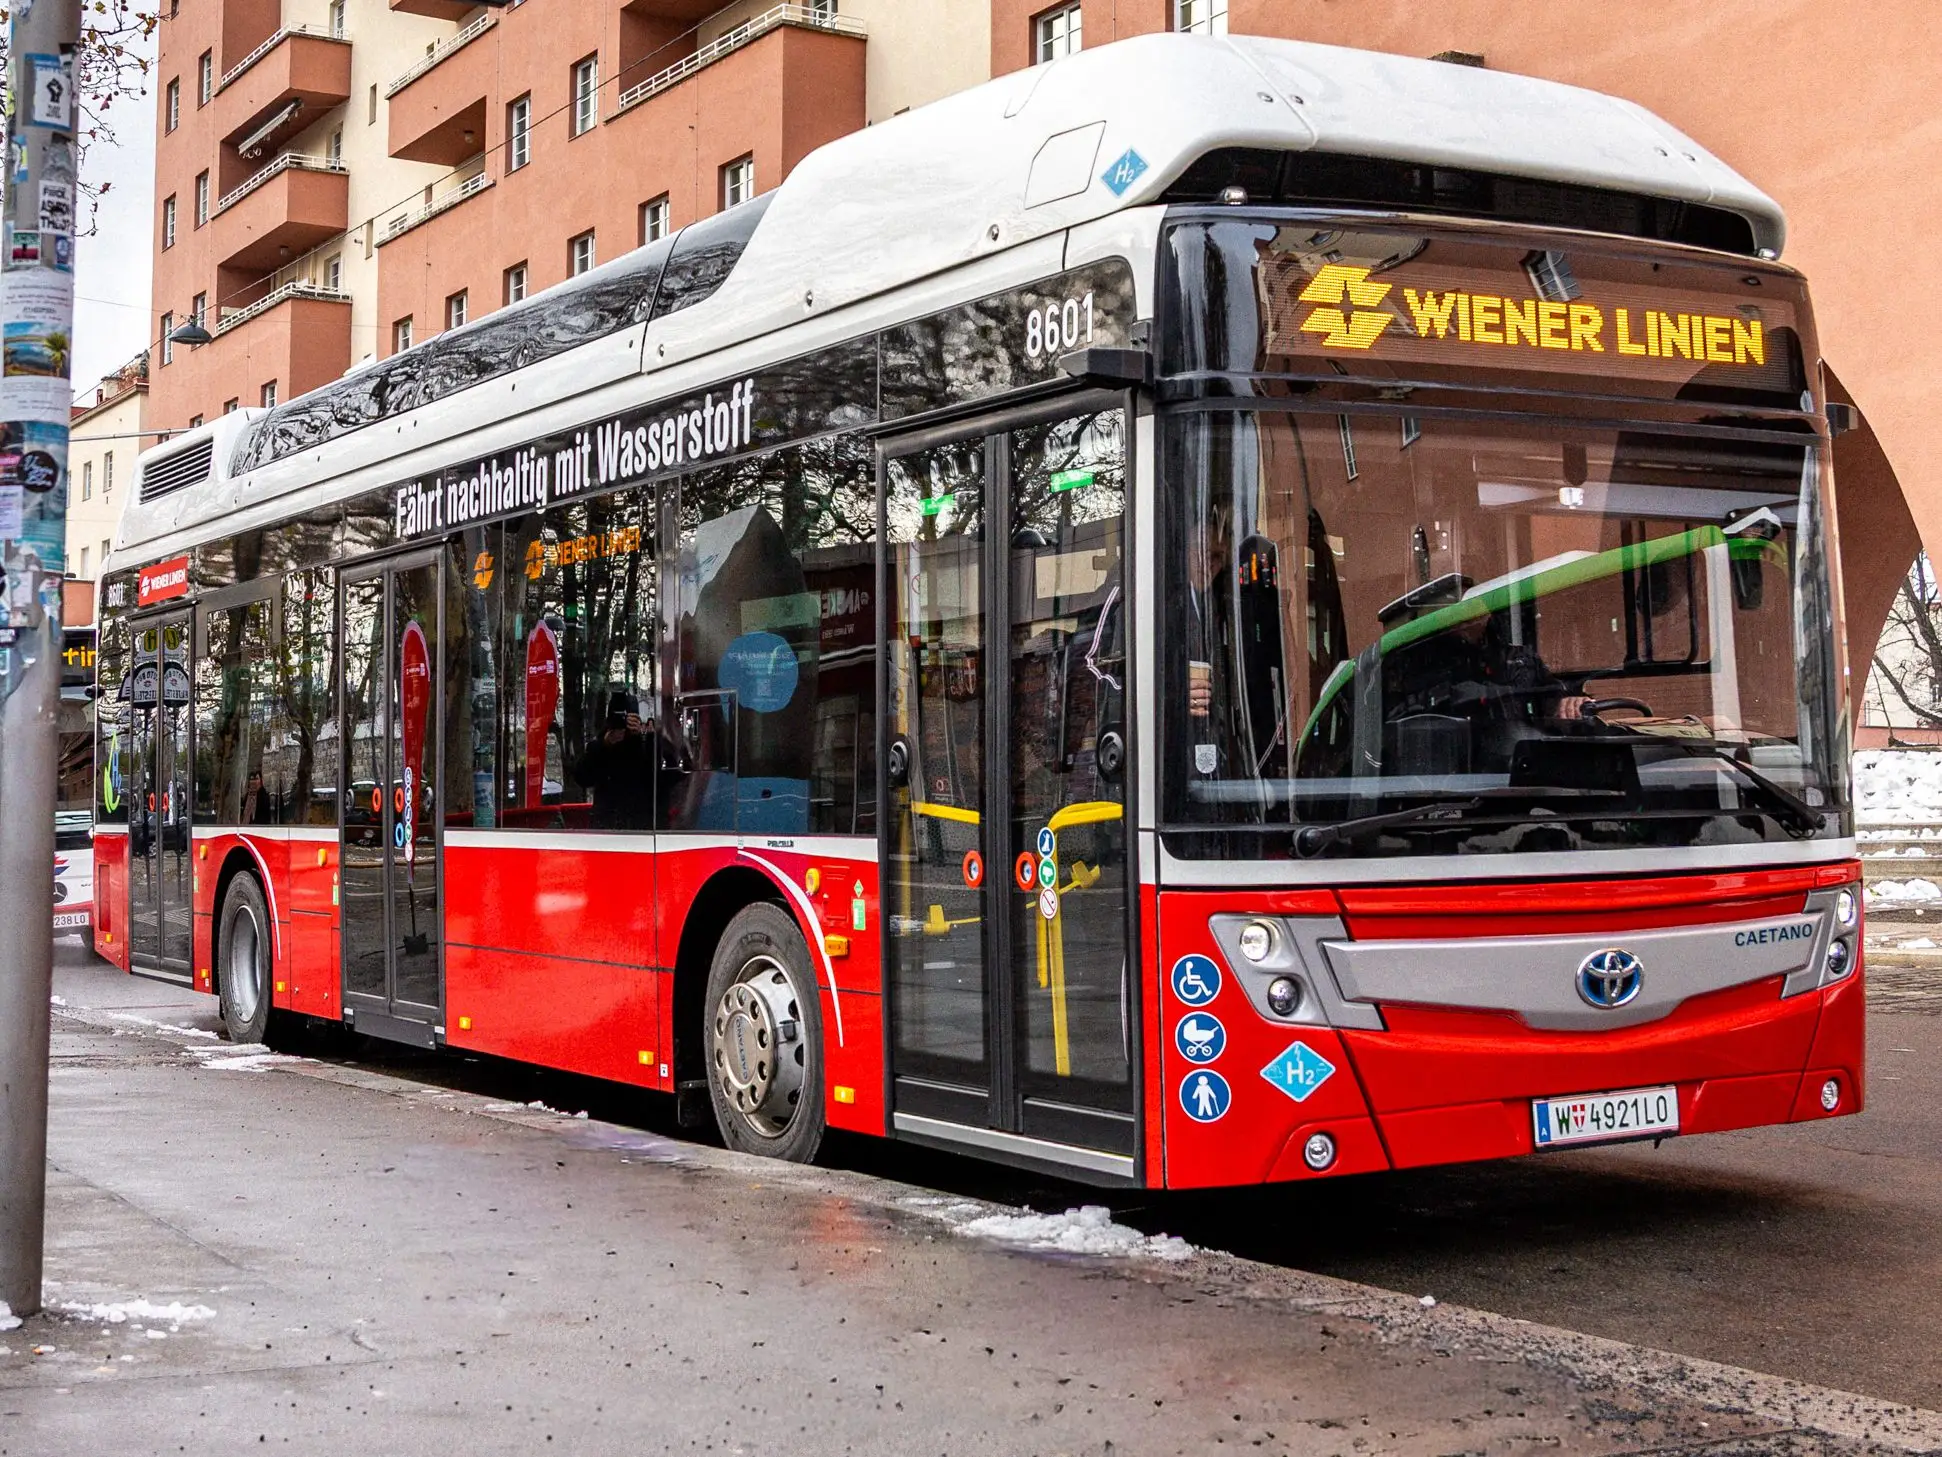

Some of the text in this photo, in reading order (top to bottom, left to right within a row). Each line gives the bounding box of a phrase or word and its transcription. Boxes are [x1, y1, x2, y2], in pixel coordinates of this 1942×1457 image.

[1026, 292, 1094, 358] 8601
[1403, 287, 1766, 365] WIENER LINIEN
[395, 378, 754, 539] Fährt nachhaltig mit Wasserstoff
[108, 581, 125, 608] 8601
[1734, 923, 1813, 947] CAETANO
[1287, 1060, 1315, 1085] H2
[1541, 1127, 1548, 1137] A
[1556, 1105, 1571, 1136] W
